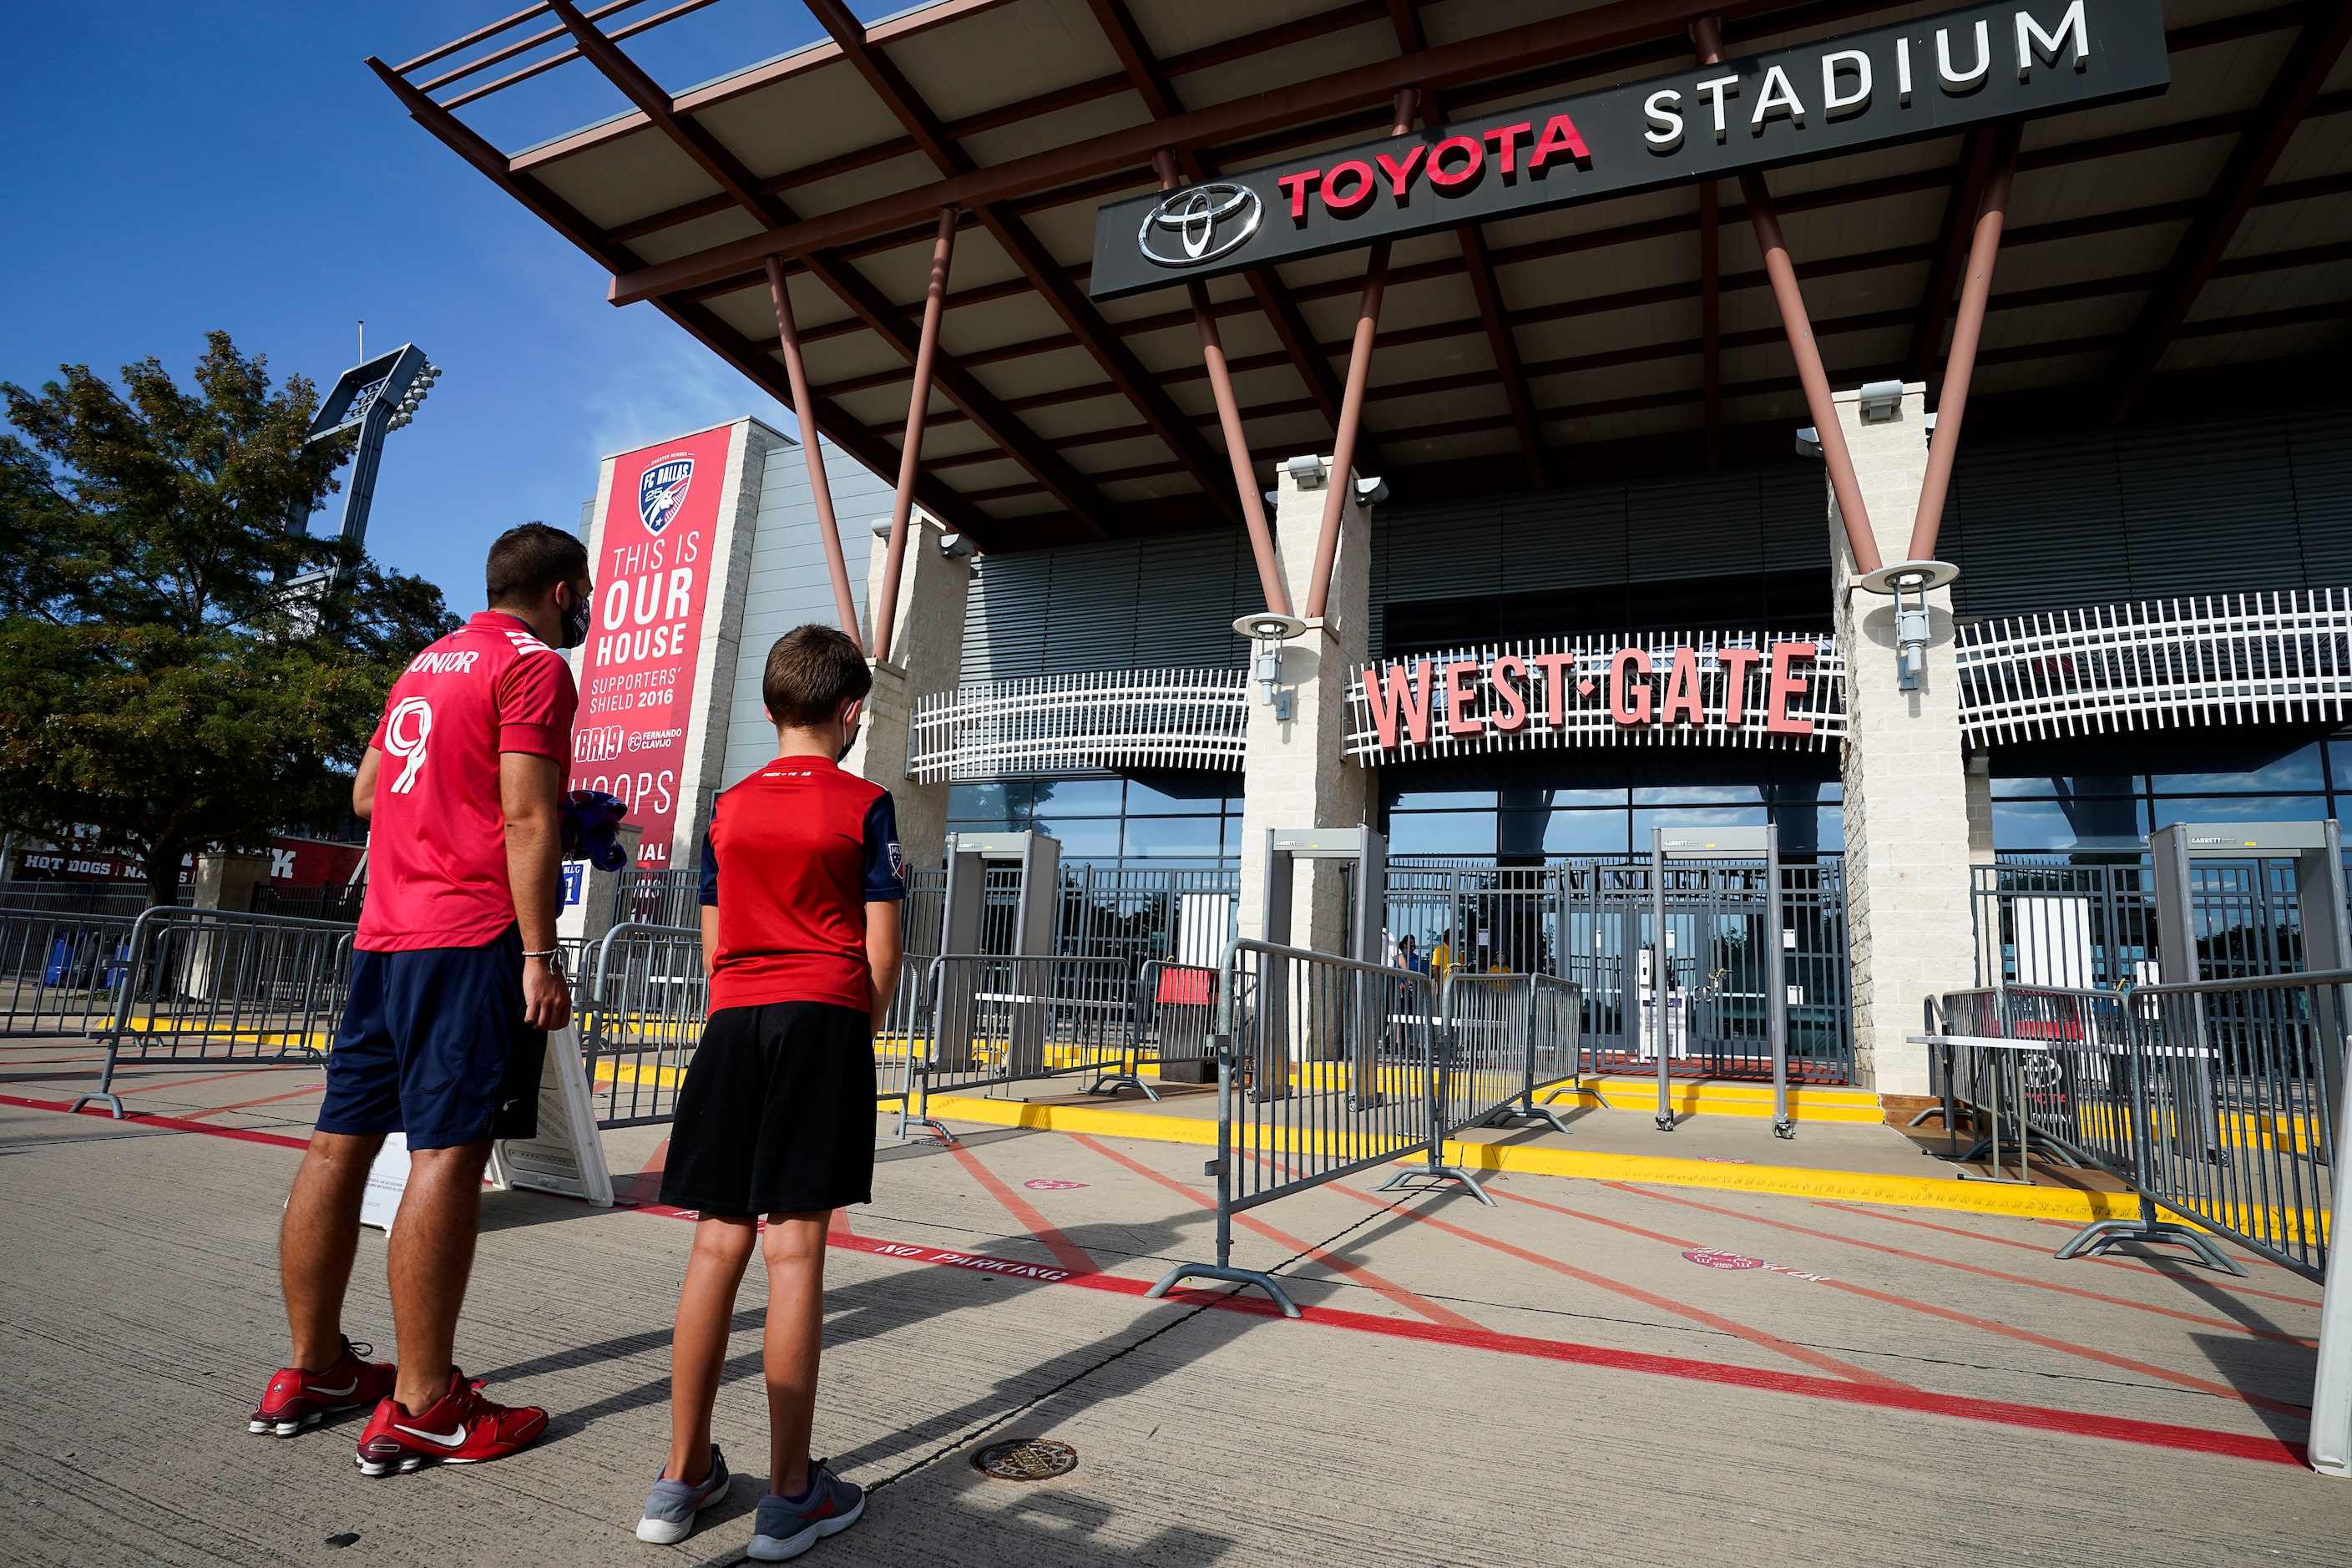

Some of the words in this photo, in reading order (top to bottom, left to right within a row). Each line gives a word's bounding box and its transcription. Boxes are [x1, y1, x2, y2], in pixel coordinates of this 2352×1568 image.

[1278, 114, 1591, 224] TOYOTA
[1643, 0, 2091, 150] STADIUM
[643, 472, 655, 491] FC
[656, 464, 689, 485] DALLAS
[645, 487, 663, 503] 25
[614, 539, 665, 577] THIS
[675, 531, 700, 564] IS
[603, 567, 693, 631] OUR
[595, 622, 687, 667] HOUSE
[590, 694, 633, 714] SHIELD
[637, 689, 673, 708] 2016
[1363, 653, 1575, 750] WEST
[1610, 642, 1816, 738] GATE
[384, 696, 432, 794] 9
[574, 725, 624, 763] BR19
[641, 739, 671, 750] CLAVIJO
[642, 728, 682, 741] FERNANDO
[24, 855, 64, 870] HOT
[67, 860, 111, 875] DOGS
[564, 876, 574, 902] 1
[874, 1244, 923, 1257] NO
[928, 1252, 1070, 1281] PARKING
